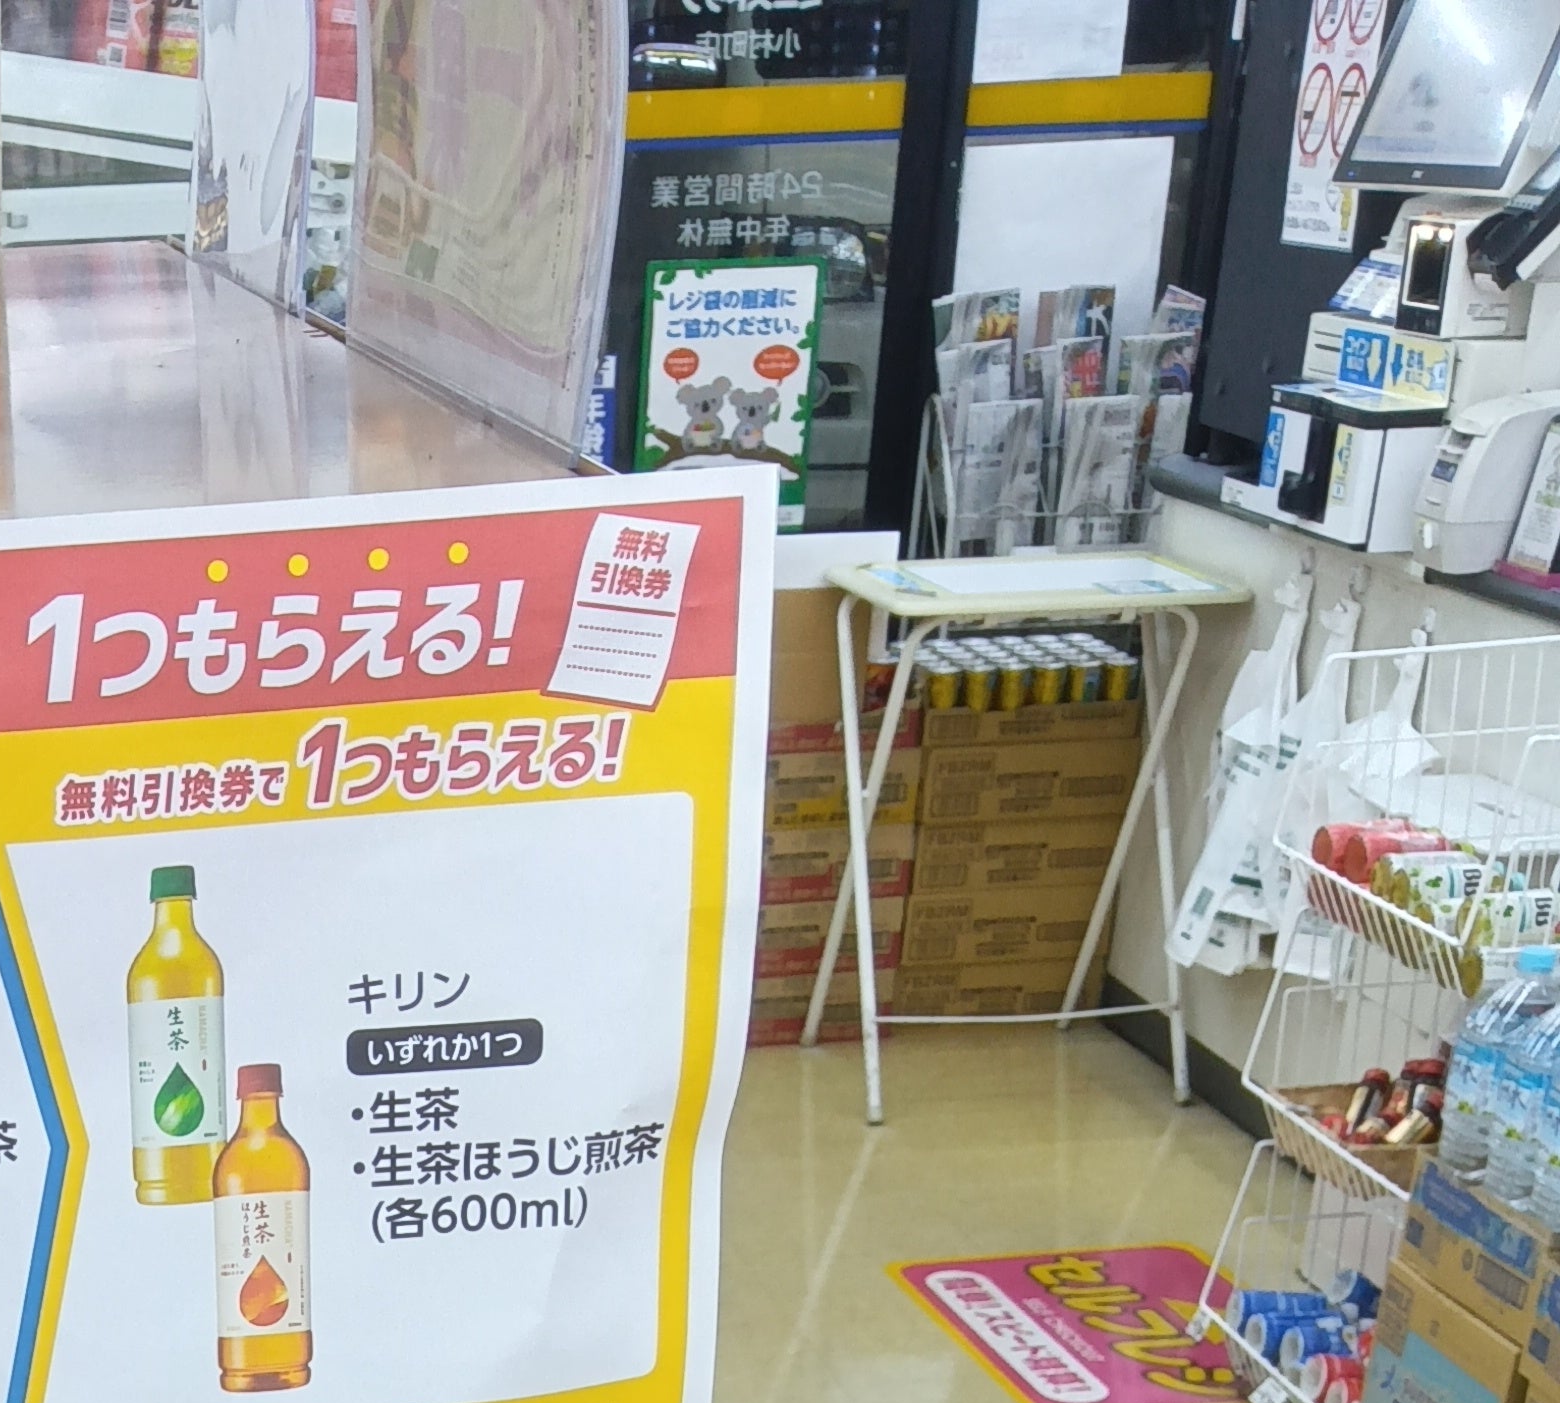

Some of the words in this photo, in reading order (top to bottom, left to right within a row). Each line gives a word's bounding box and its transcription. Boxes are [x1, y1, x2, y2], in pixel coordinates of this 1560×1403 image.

[668, 288, 797, 311] レジ袋の削減に
[666, 317, 800, 339] ご協力ください。
[612, 525, 669, 562] 無料
[589, 561, 674, 602] 引換券
[25, 578, 526, 705] 1つもらえる!
[347, 971, 471, 1013] キリン
[167, 1006, 189, 1051] 生茶
[366, 1034, 523, 1065] いずれか1つ
[253, 1200, 275, 1244] 生茶
[370, 1186, 589, 1242] (各600ml)
